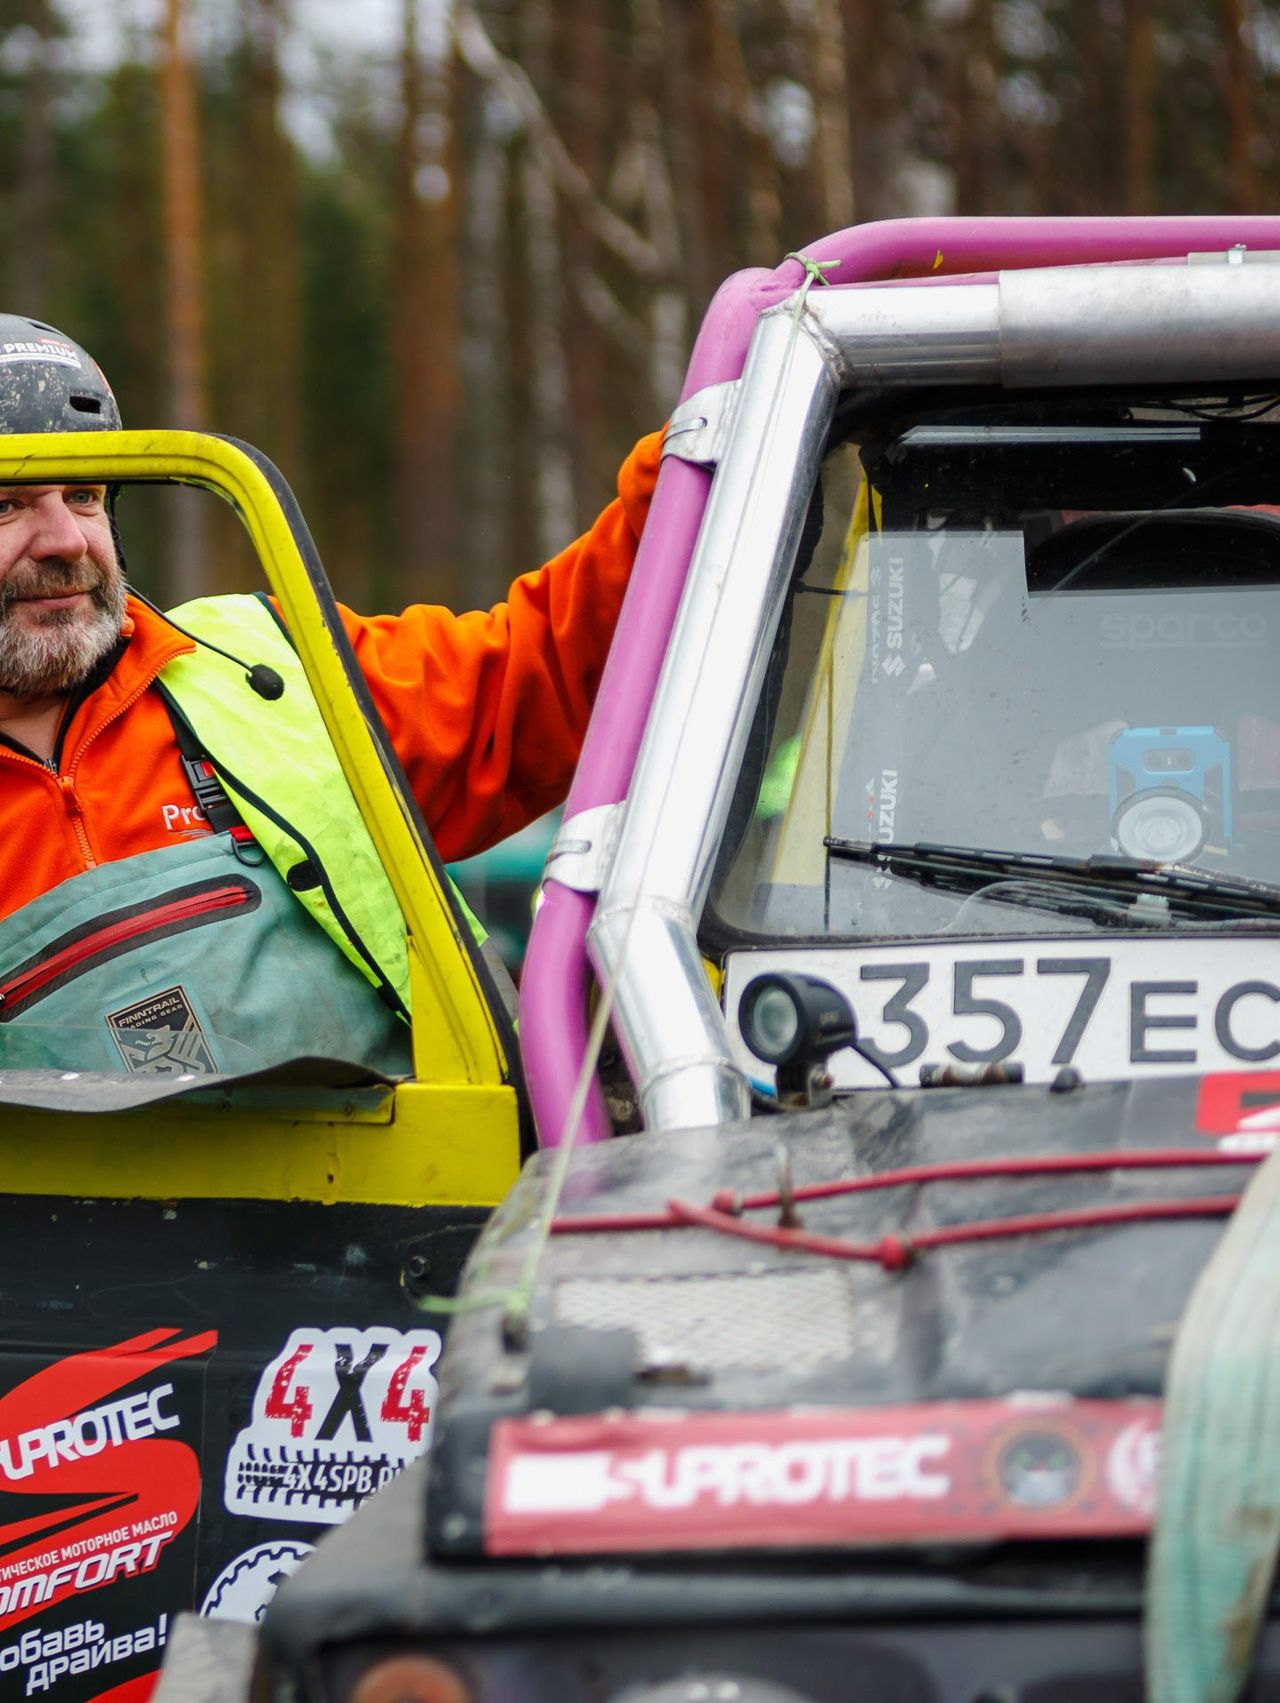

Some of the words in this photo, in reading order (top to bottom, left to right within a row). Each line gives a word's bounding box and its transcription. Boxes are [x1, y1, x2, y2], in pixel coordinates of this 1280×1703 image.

[3, 342, 79, 360] PREMIUM
[886, 557, 904, 650] SUZUKI
[1099, 611, 1268, 650] sparco
[118, 997, 180, 1027] FINNTRAIL
[160, 1004, 183, 1017] GEAR
[265, 1343, 431, 1443] 4X4
[282, 1463, 402, 1494] 4X4SPB.R
[603, 1434, 951, 1508] SUPROTEC
[62, 1526, 131, 1561] МОТОРНОЕ
[132, 1511, 179, 1538] МАСЛО
[26, 1613, 168, 1697] драйва!
